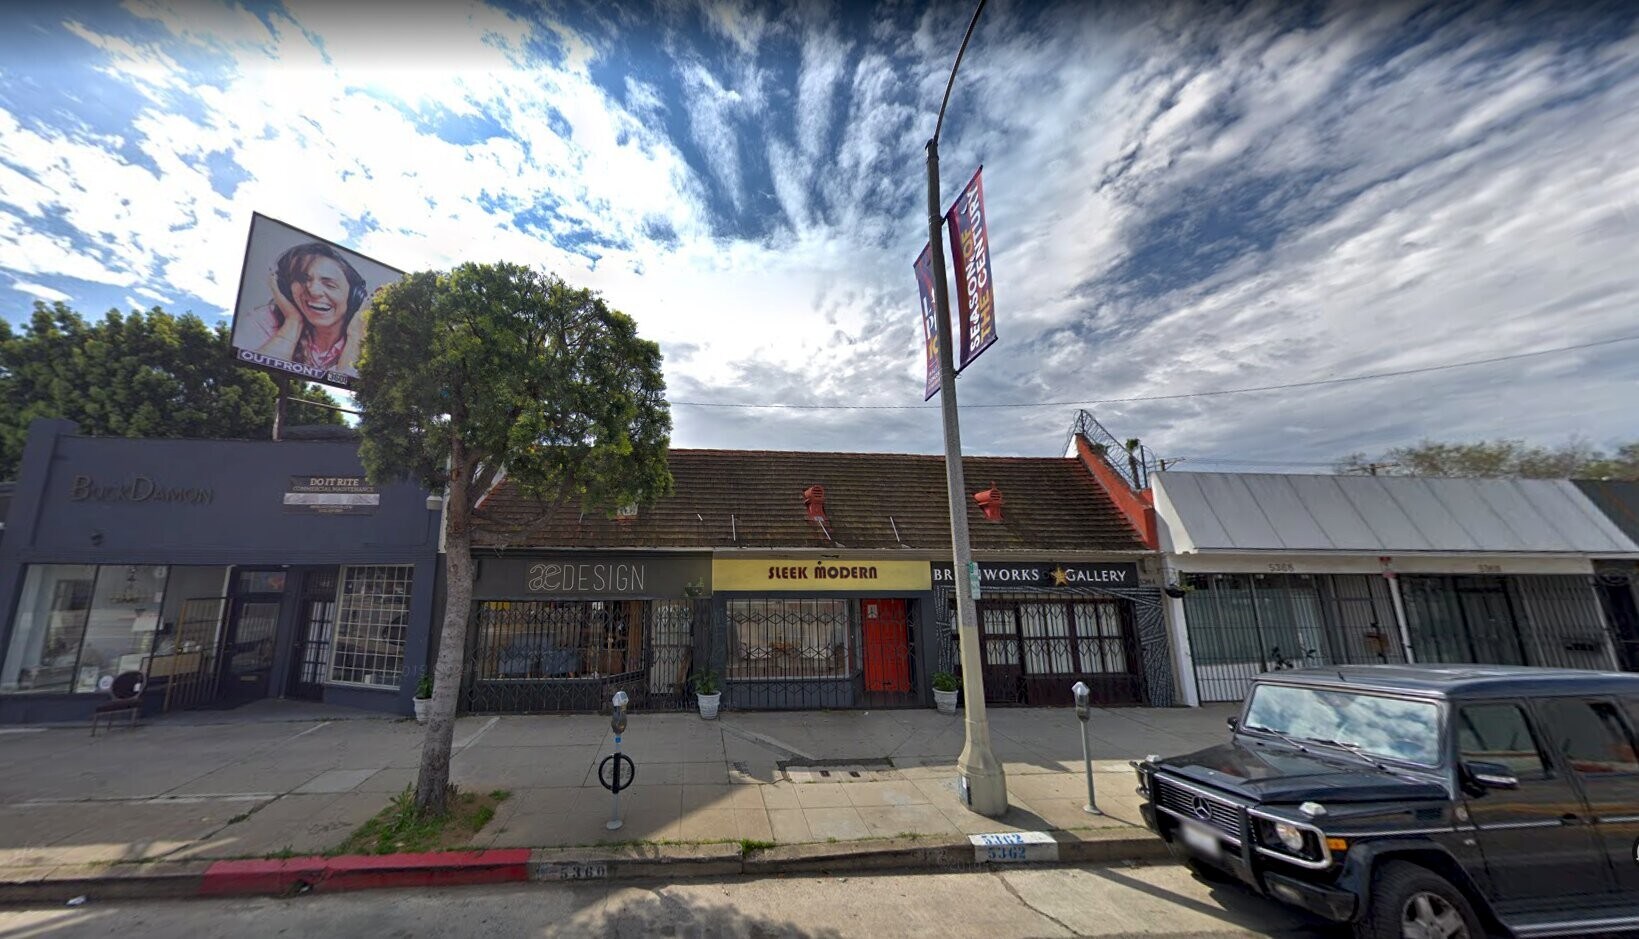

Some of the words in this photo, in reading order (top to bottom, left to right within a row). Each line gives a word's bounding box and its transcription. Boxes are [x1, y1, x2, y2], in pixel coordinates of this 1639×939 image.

[961, 229, 975, 259] OF
[967, 186, 988, 288] CENTURY
[966, 257, 981, 352] SEASON
[979, 289, 992, 345] THE
[336, 478, 360, 486] RITE
[768, 566, 808, 580] SLEEK
[814, 566, 878, 579] MODERN
[1065, 568, 1126, 582] GALLERY
[988, 847, 1026, 859] 5362
[561, 863, 606, 879] 5360
